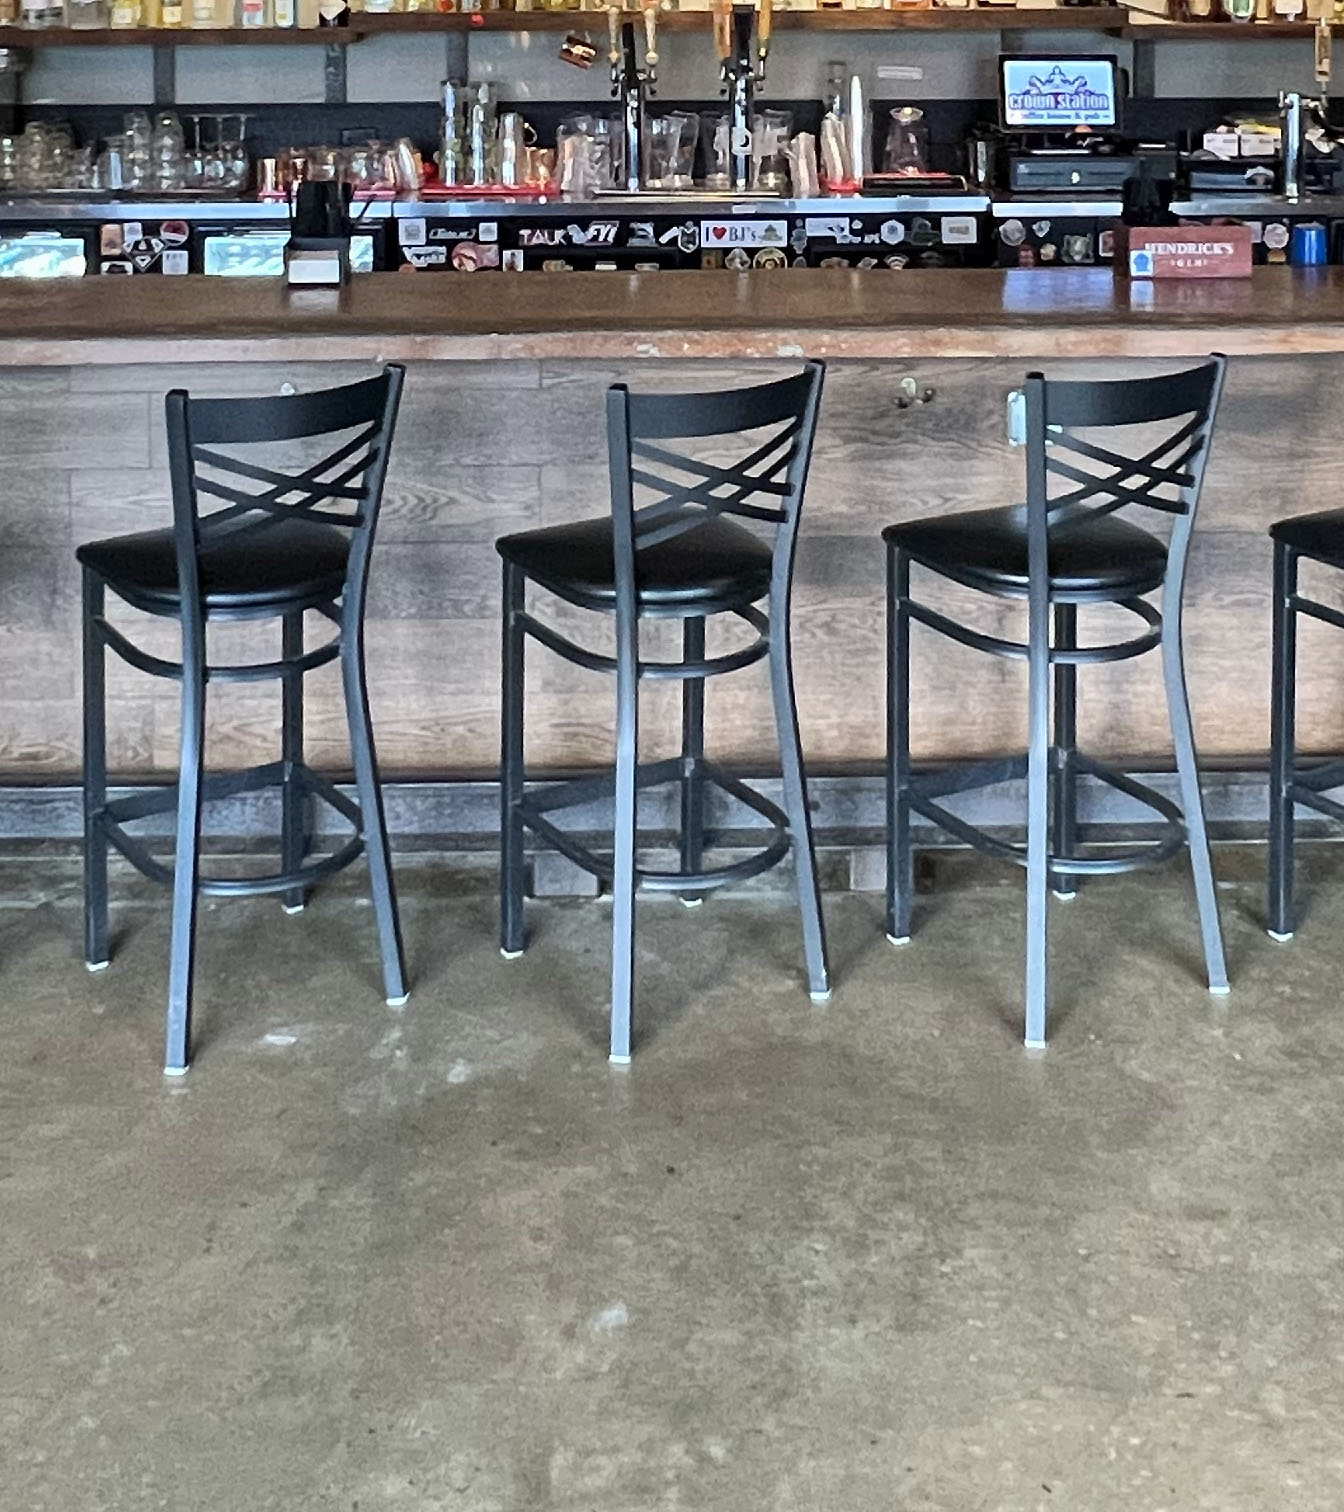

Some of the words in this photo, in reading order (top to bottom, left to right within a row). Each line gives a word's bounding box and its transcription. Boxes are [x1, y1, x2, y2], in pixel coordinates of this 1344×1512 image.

[1009, 94, 1055, 109] crown
[1056, 91, 1108, 109] station
[705, 226, 710, 242] I
[729, 226, 757, 242] BJ's
[1144, 242, 1234, 255] HENDRICK'S
